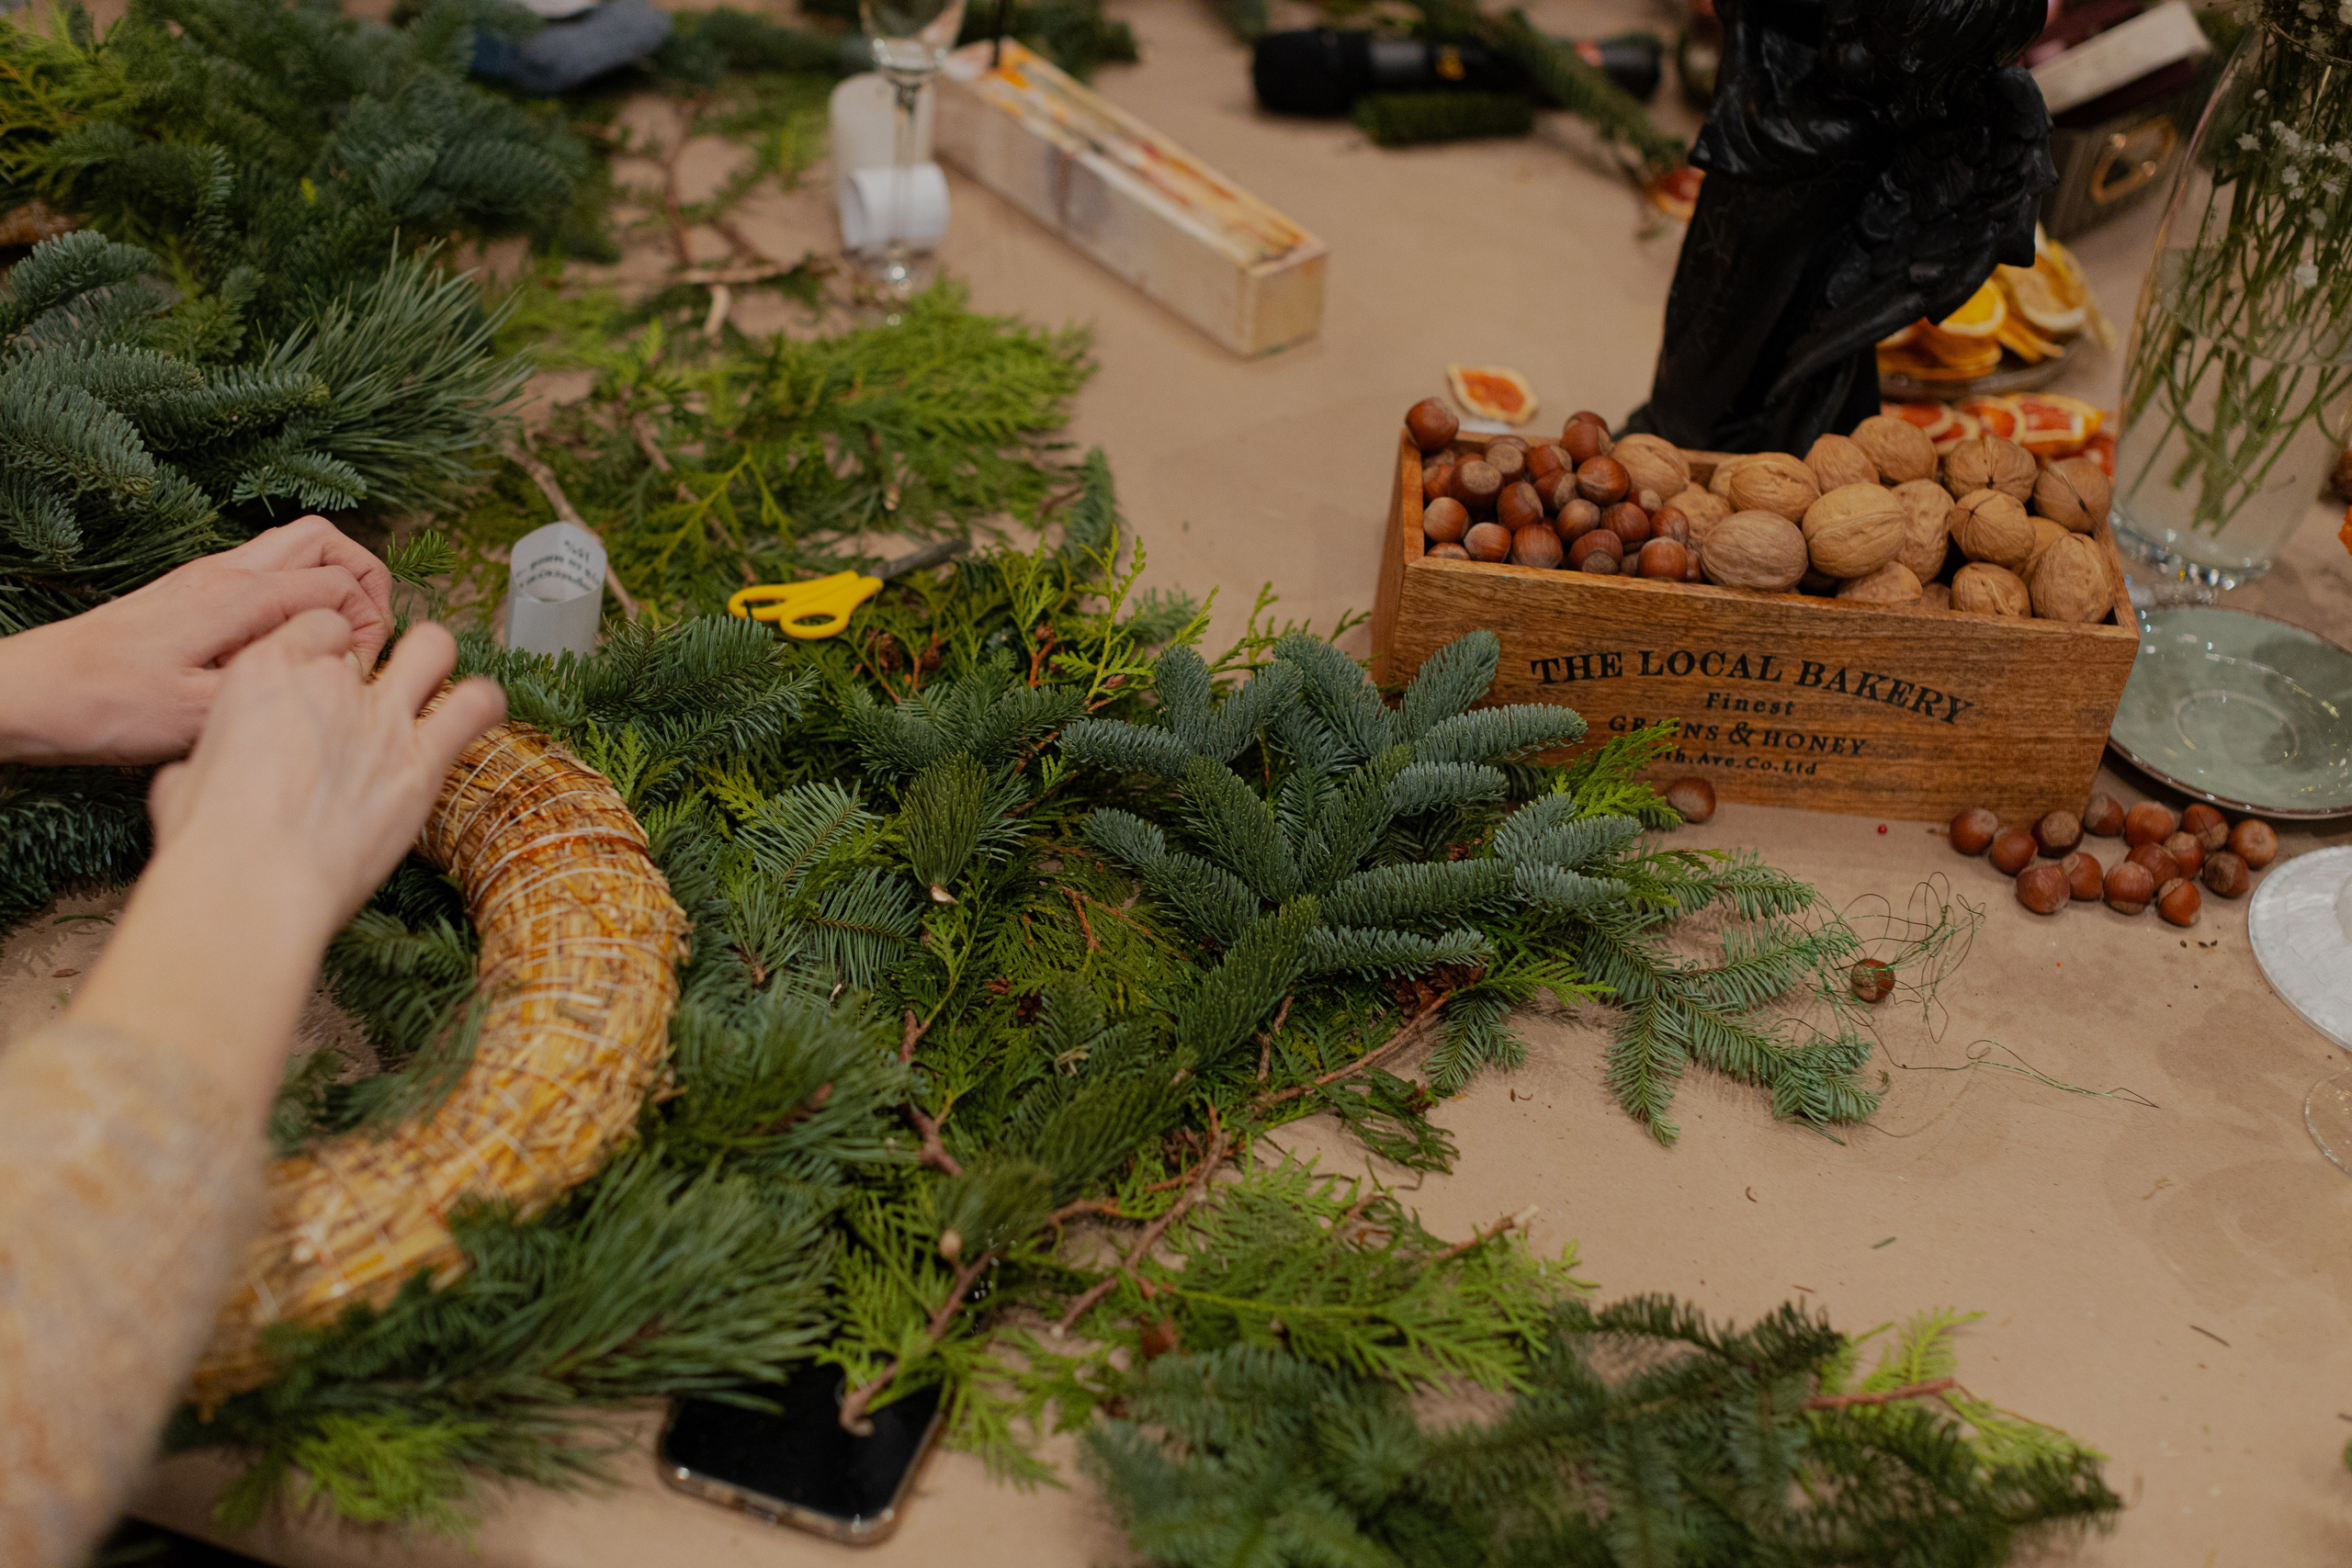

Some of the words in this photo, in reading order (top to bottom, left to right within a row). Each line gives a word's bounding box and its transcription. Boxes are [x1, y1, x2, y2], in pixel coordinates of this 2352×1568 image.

[1530, 651, 1623, 685] THE
[1637, 649, 1783, 682] LOCAL
[1792, 659, 1974, 726] BAKERY
[1705, 692, 1794, 716] Finest
[1608, 716, 1720, 741] GRINS
[1728, 721, 1755, 748] &
[1762, 729, 1867, 756] HONEY
